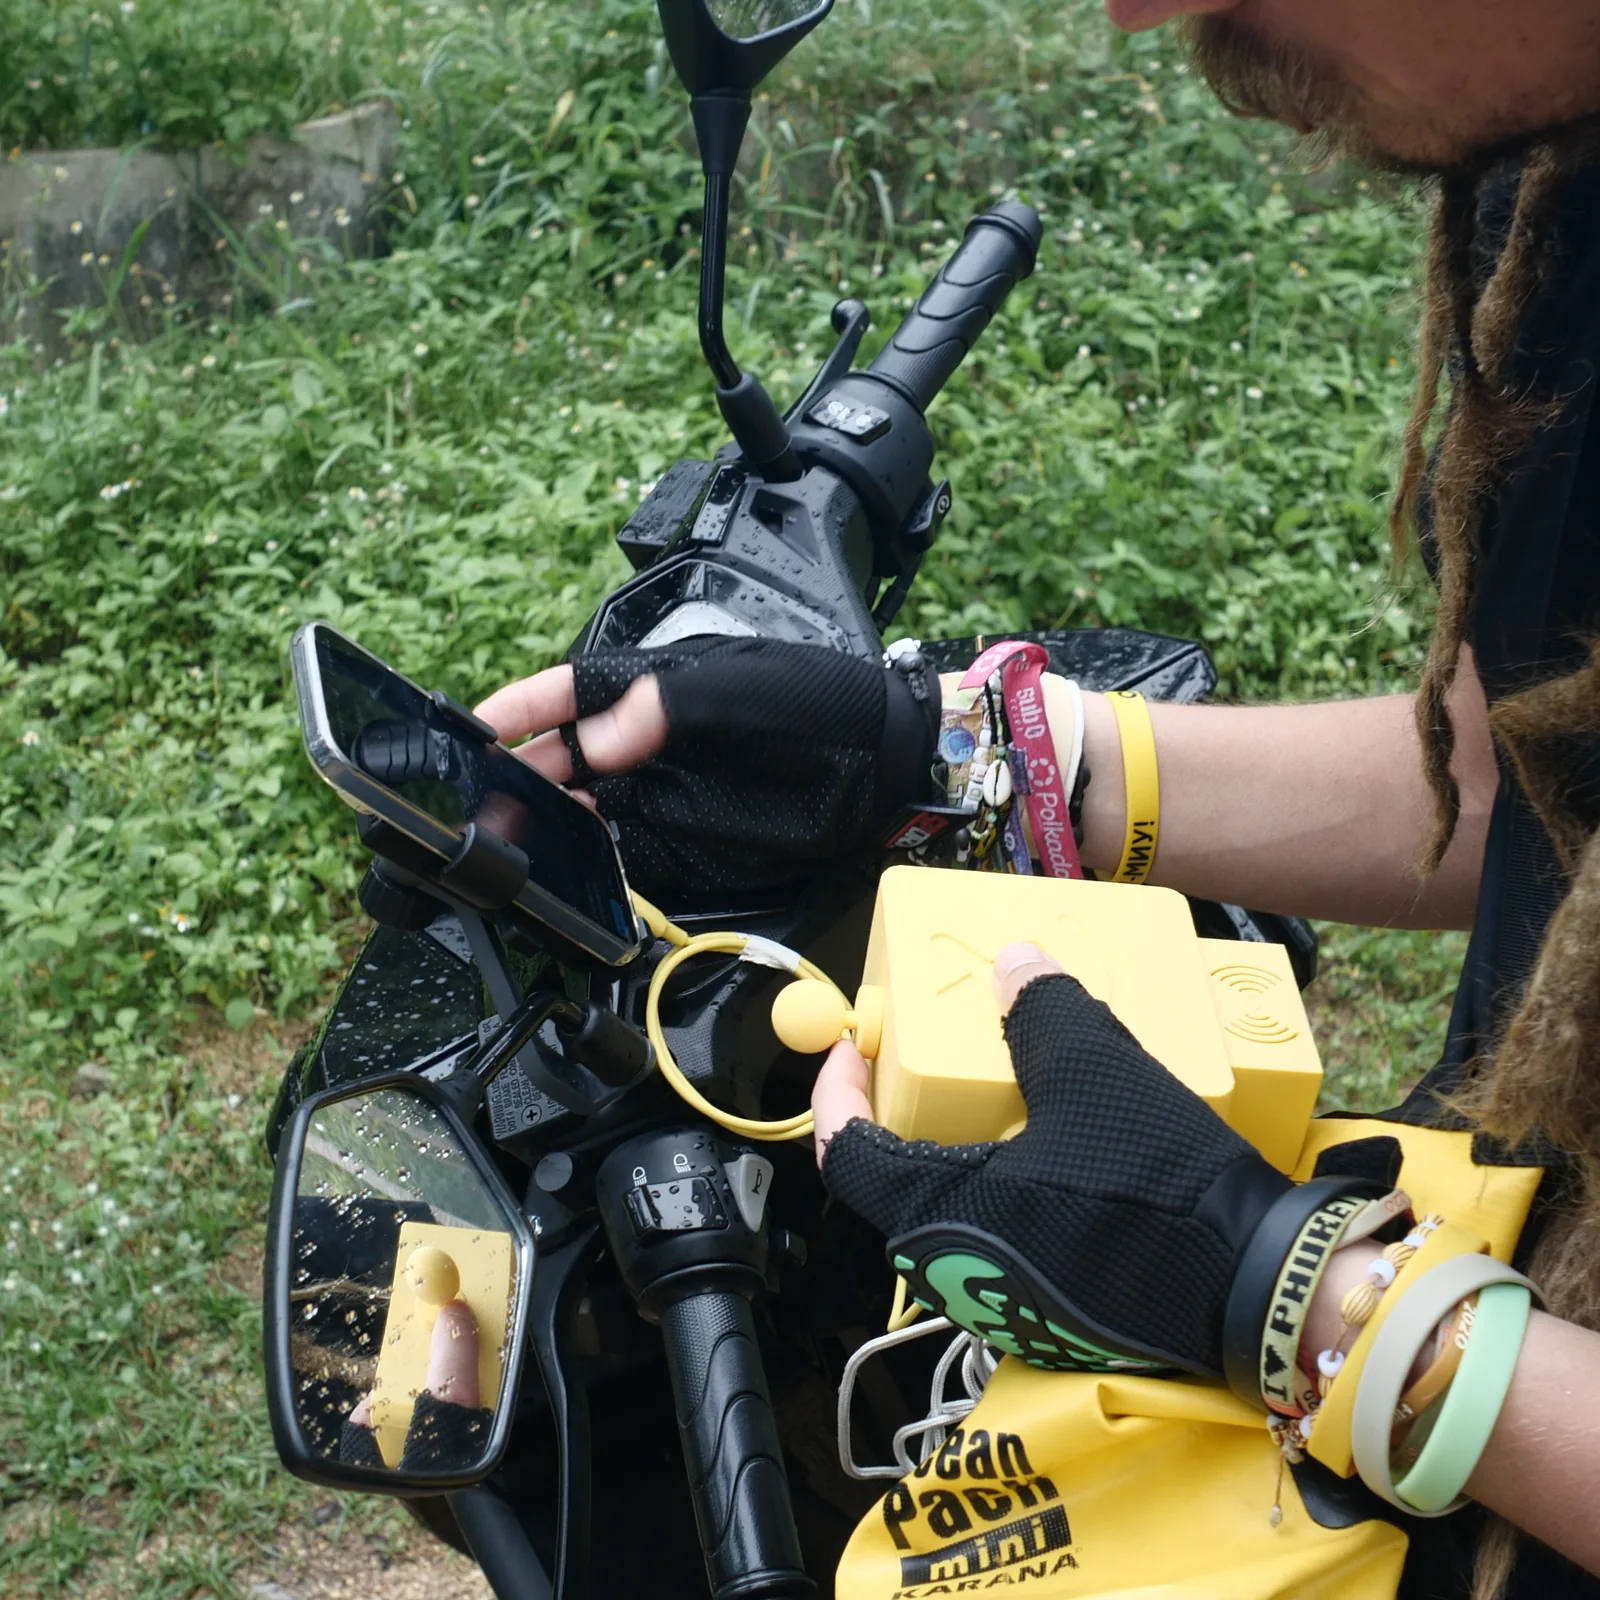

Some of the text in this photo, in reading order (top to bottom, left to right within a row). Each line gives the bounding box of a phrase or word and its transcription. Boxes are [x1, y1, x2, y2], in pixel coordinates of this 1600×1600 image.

[501, 1082, 513, 1109] BRAKE
[510, 1078, 523, 1109] SEALED
[520, 1079, 533, 1105] CLEAN
[929, 1516, 1047, 1582] mini
[891, 1552, 1080, 1600] KARANA
